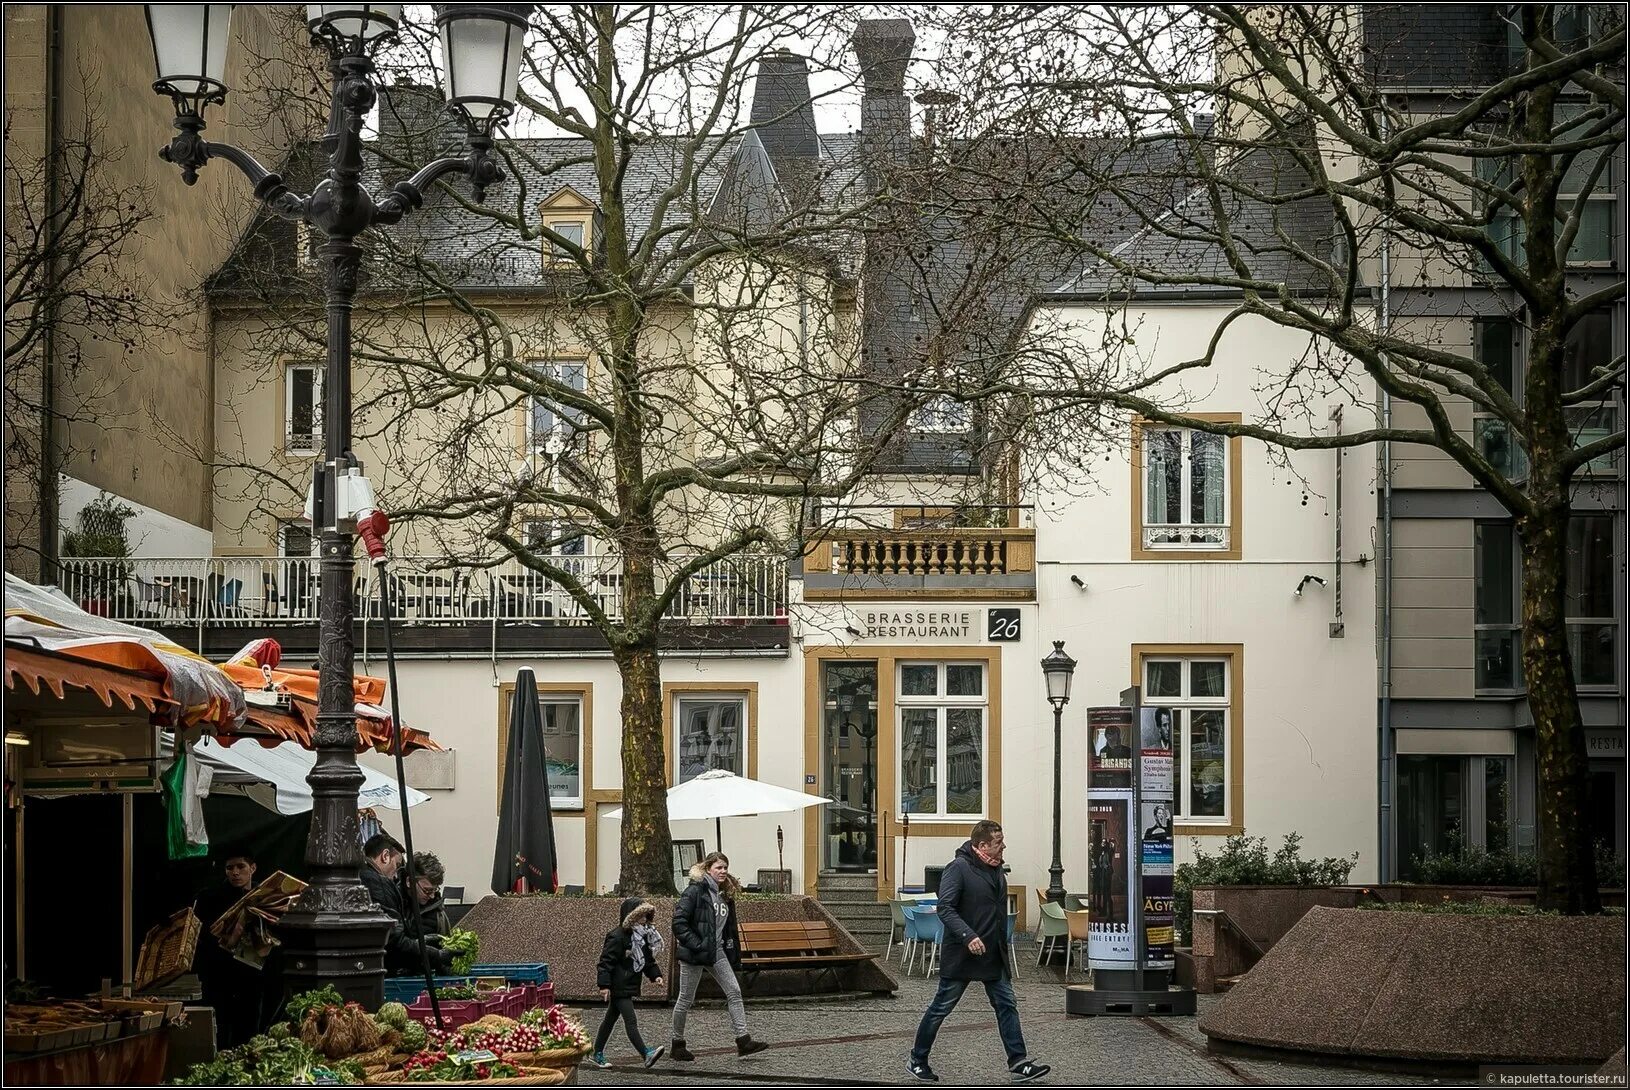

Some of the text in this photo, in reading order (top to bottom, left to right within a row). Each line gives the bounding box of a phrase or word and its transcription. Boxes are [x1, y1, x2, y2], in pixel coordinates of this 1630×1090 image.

[867, 613, 970, 624] BRASSERIE
[867, 626, 969, 637] RESTAURANT
[989, 618, 1020, 638] 26
